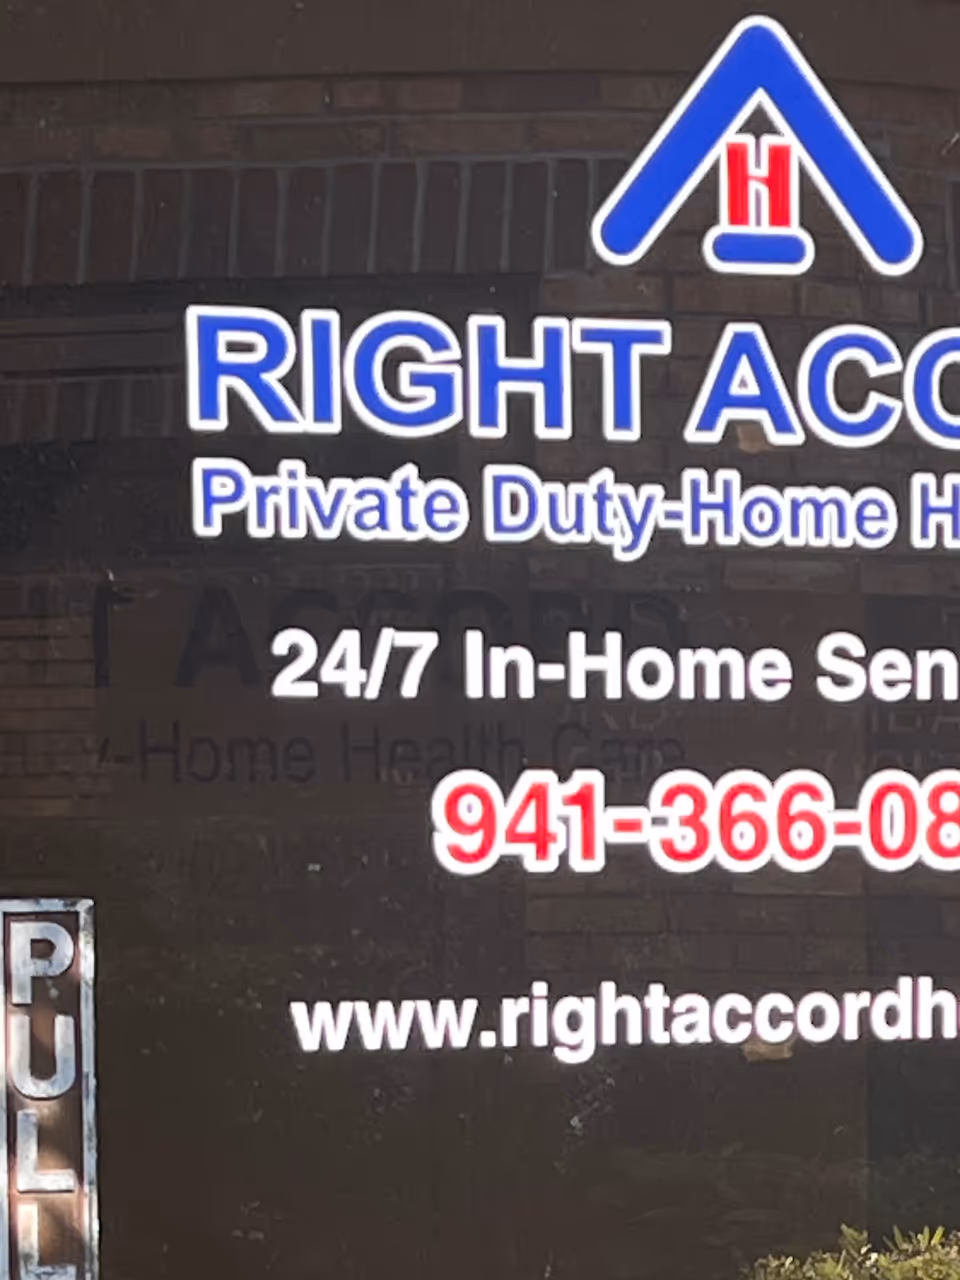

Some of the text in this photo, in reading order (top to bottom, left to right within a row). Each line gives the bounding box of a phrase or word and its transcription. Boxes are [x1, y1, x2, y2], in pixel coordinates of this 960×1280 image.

[186, 305, 671, 441] RIGHT
[193, 458, 469, 542] Private
[483, 464, 898, 562] Duty-Home
[272, 628, 438, 699] 24/7
[466, 630, 792, 701] In-Home
